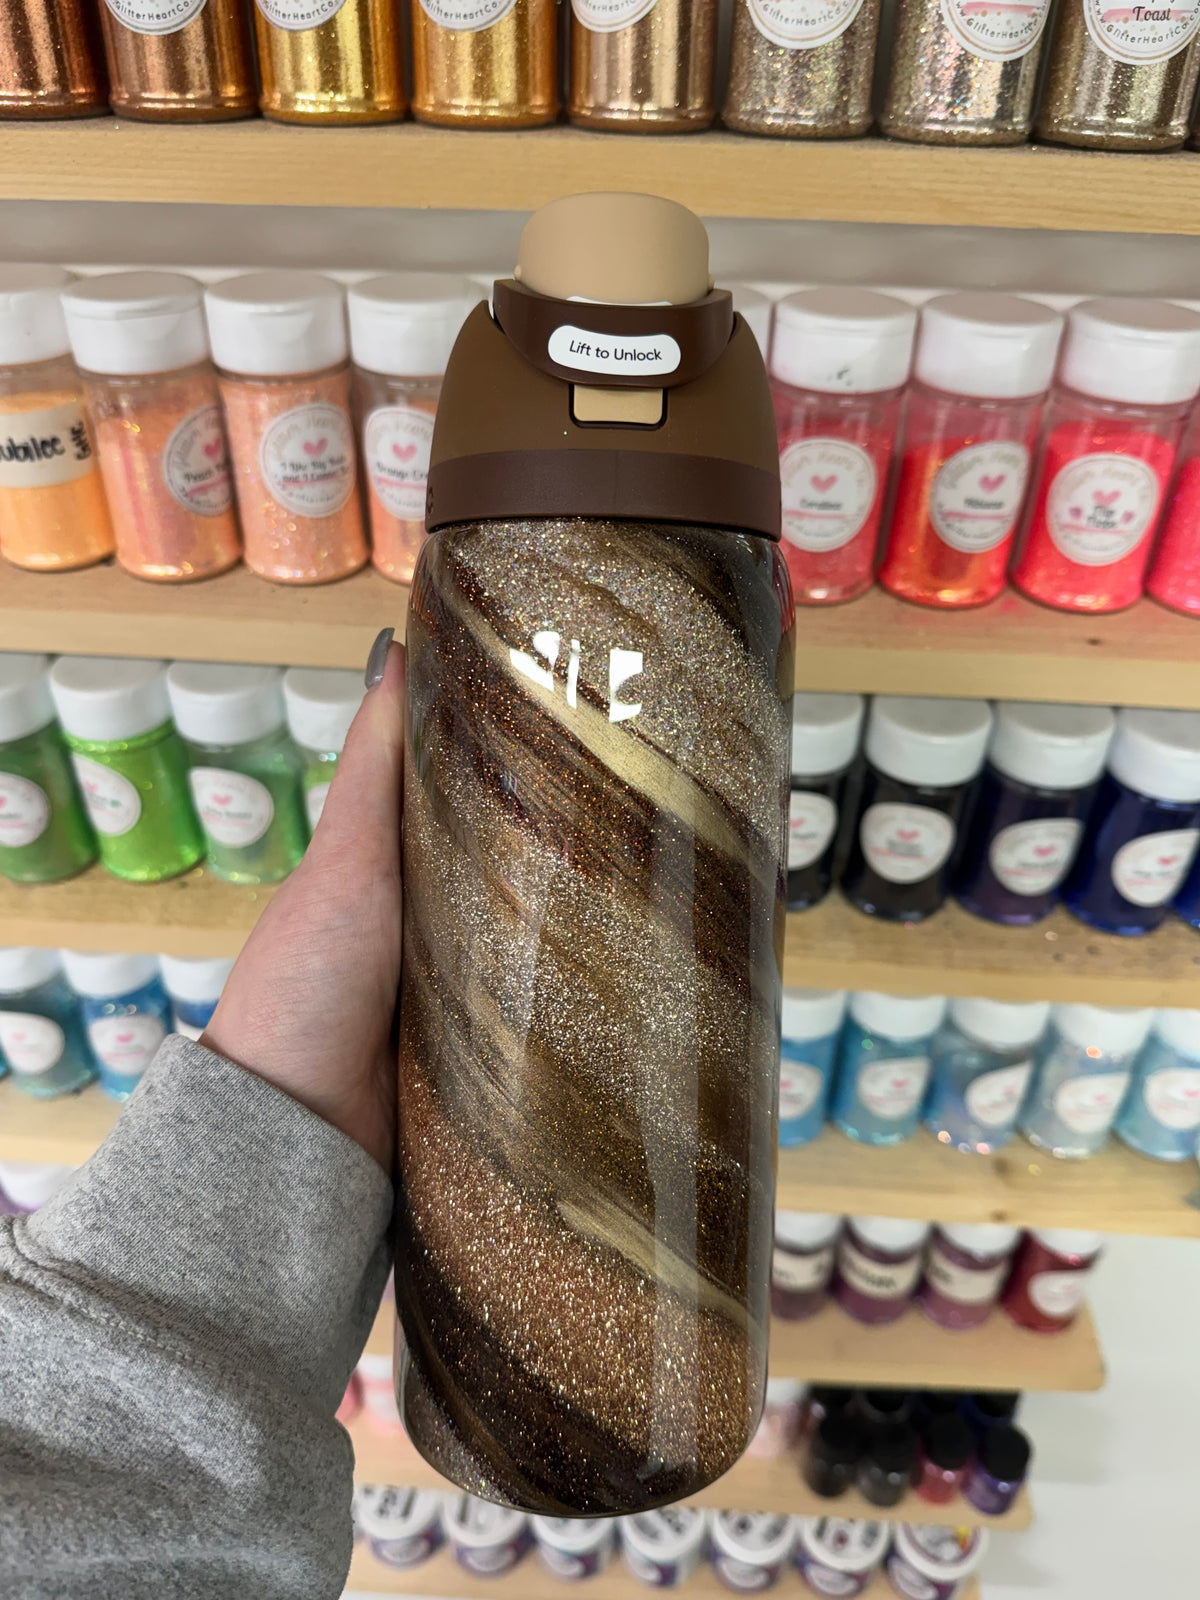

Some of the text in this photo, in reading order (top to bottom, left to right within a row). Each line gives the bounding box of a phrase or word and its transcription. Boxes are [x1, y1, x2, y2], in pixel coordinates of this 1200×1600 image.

[1132, 6, 1171, 21] Toast
[569, 340, 663, 362] Lift to Unlock
[0, 435, 65, 463] ubilee
